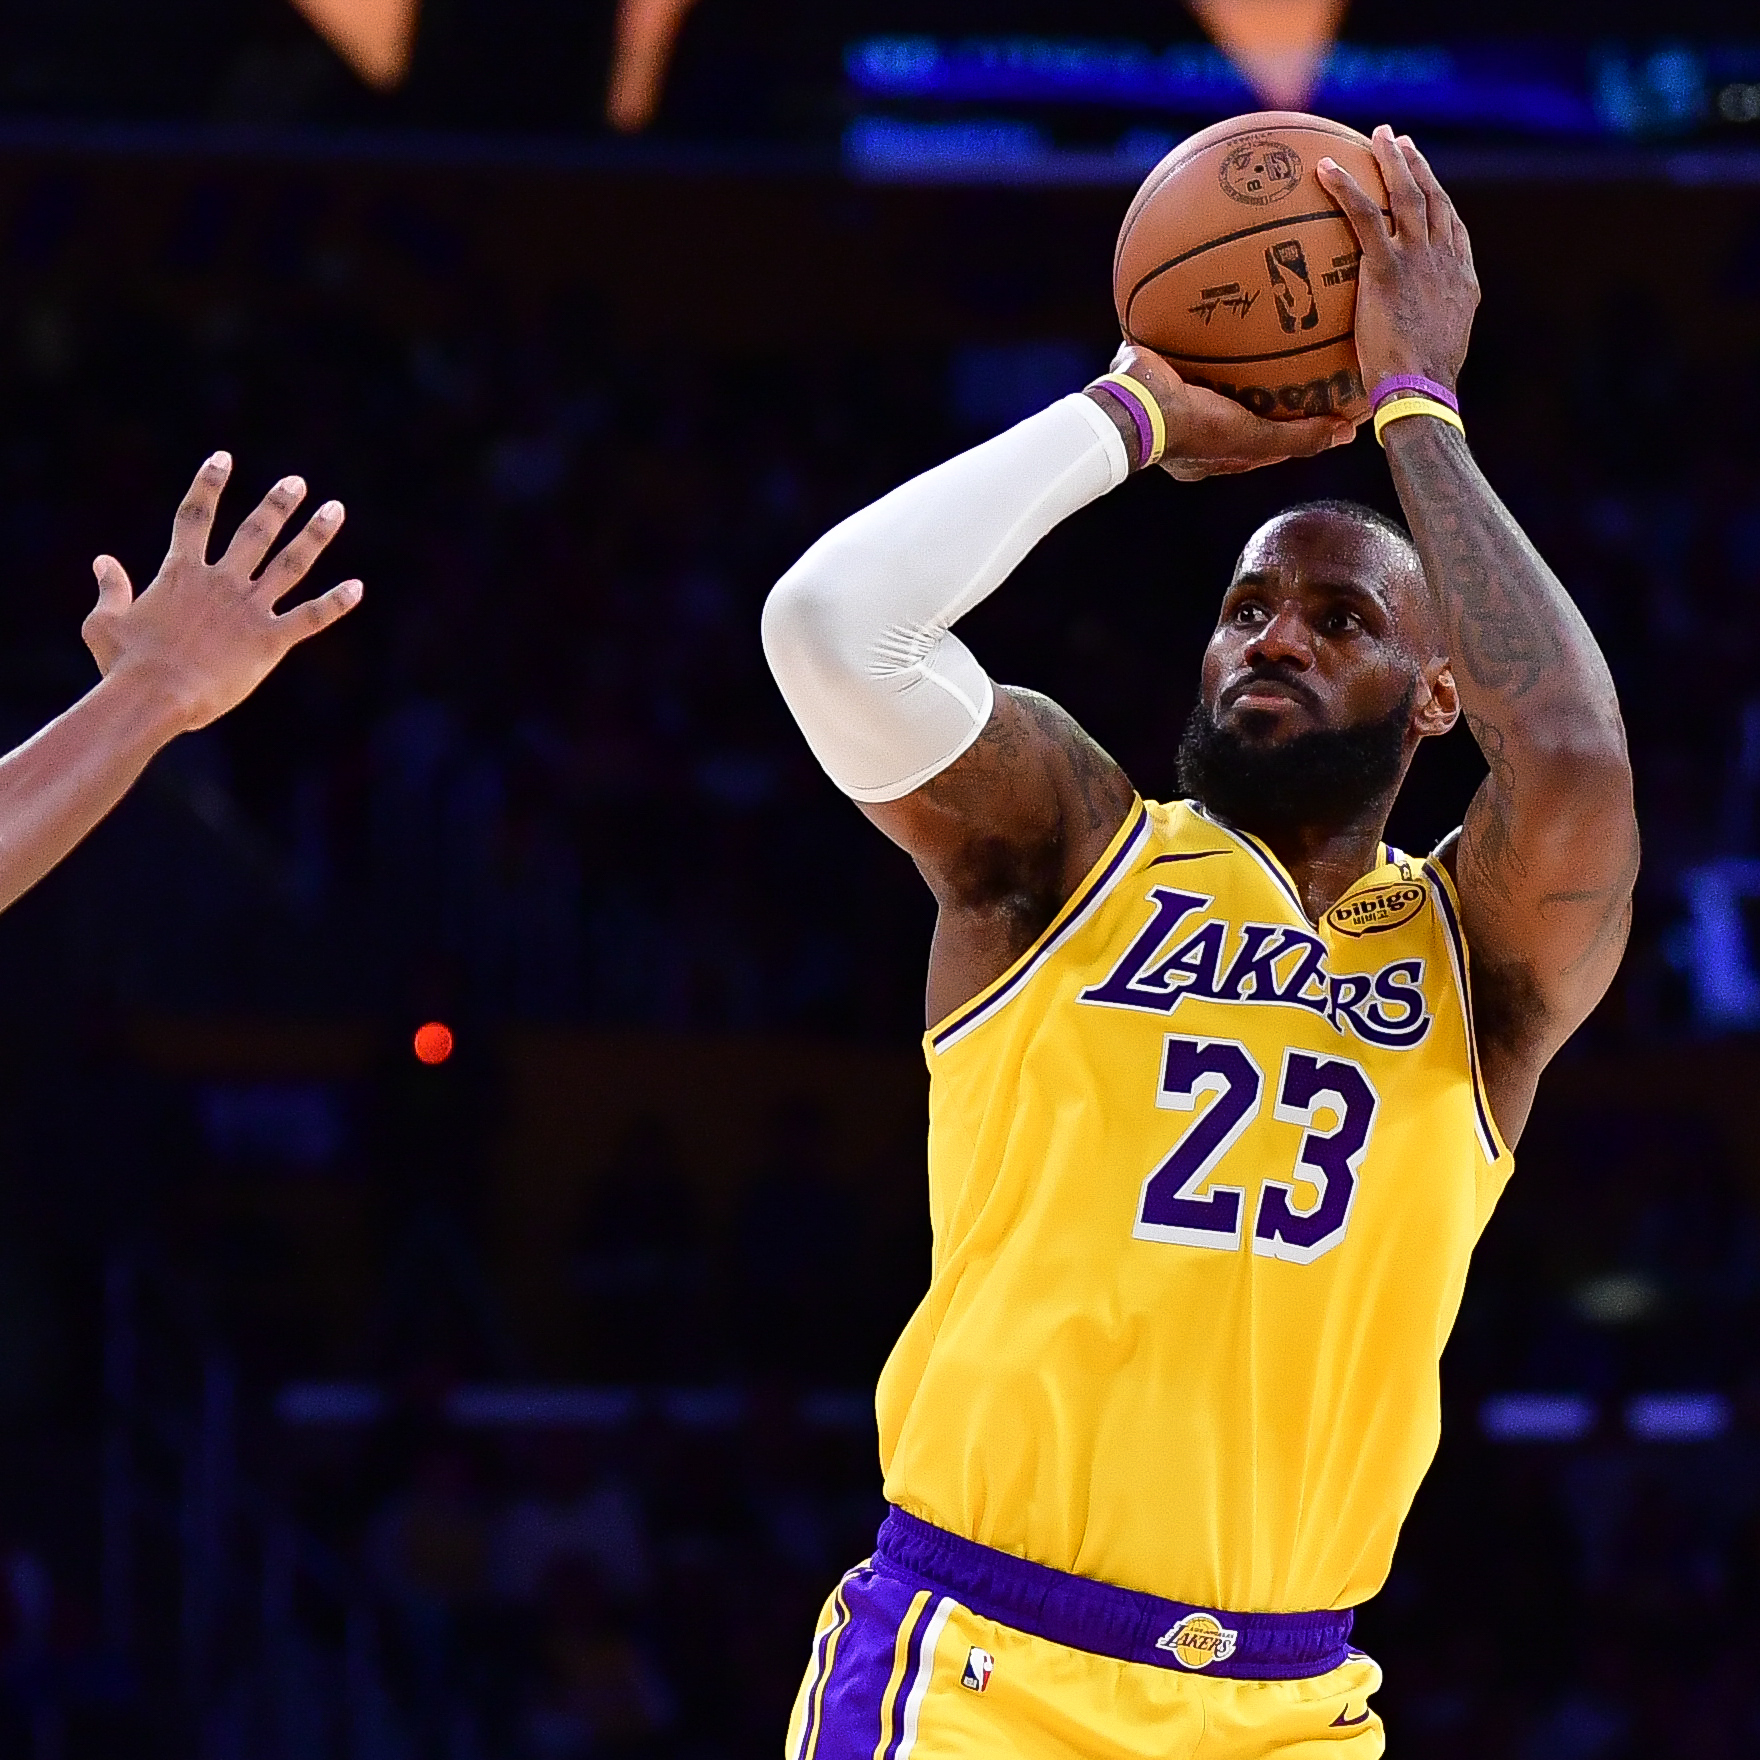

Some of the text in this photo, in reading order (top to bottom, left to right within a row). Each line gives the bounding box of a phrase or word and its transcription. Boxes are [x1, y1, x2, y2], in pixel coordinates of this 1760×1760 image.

[1335, 889, 1420, 921] bibigo
[1076, 884, 1434, 1051] LAKERS
[1132, 1033, 1381, 1265] 23
[1158, 1624, 1232, 1659] LAKERS
